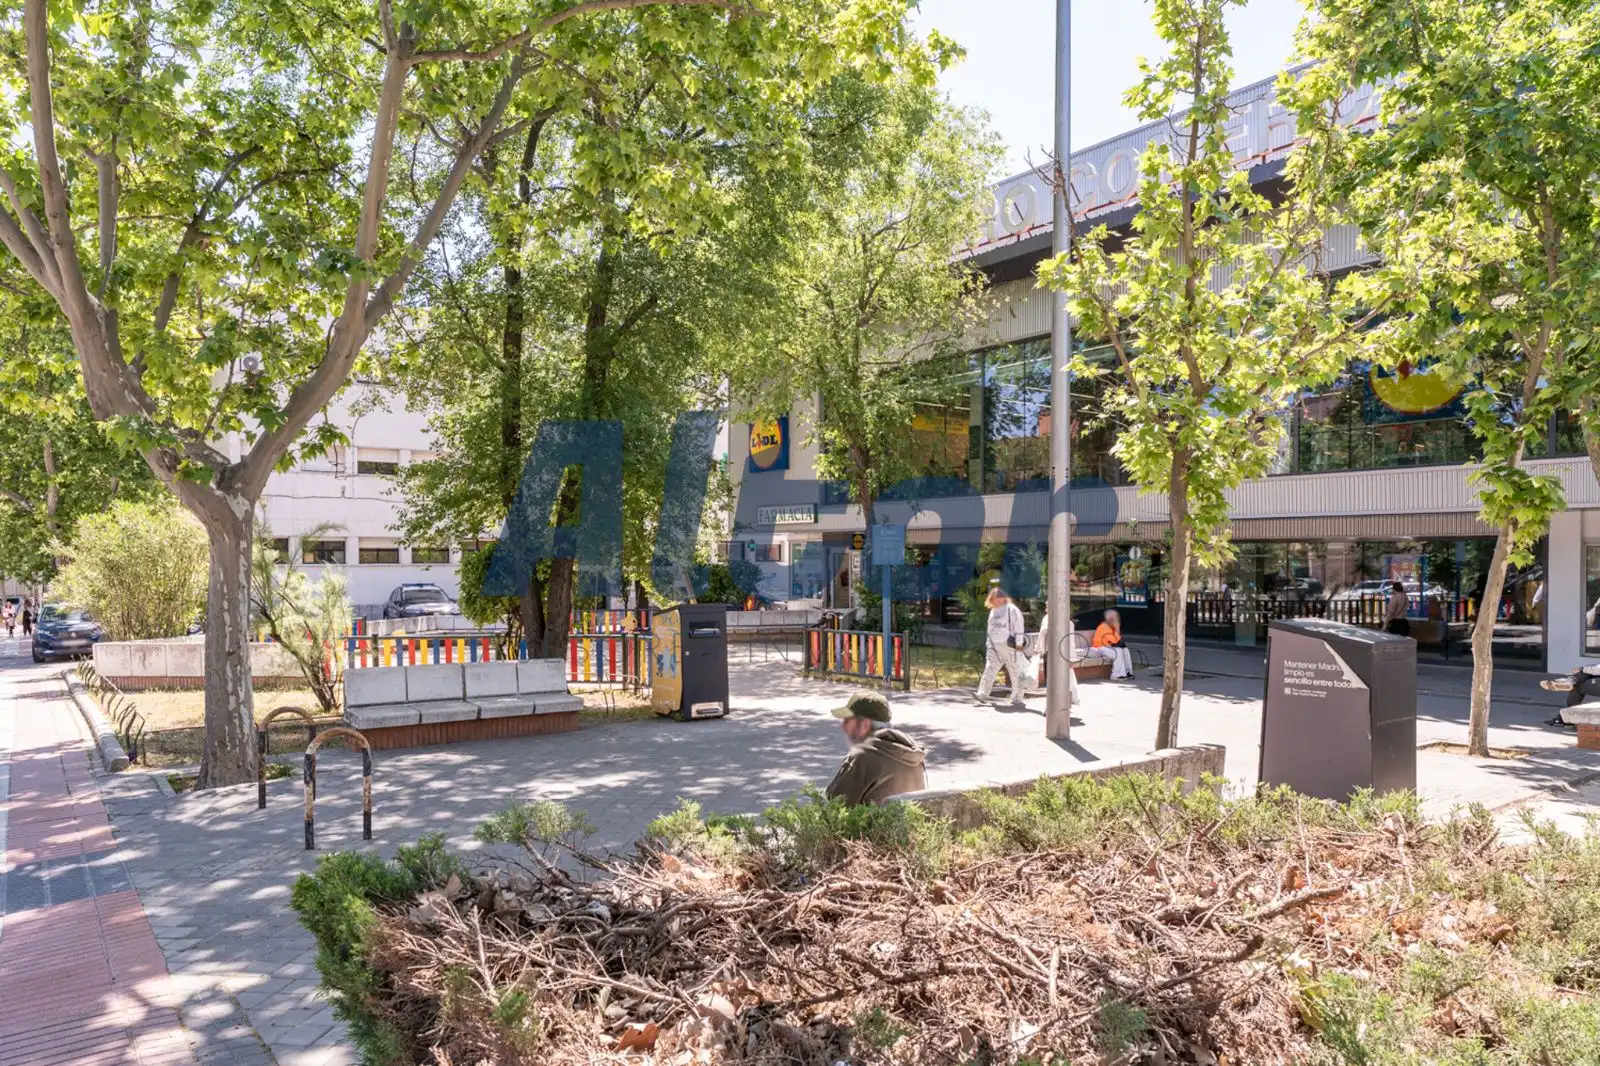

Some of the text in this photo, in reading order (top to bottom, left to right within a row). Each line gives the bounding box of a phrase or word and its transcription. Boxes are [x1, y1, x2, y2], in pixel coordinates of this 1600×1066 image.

[759, 508, 813, 522] FARMACIA
[1284, 660, 1317, 670] Mantener
[1284, 668, 1305, 676] limpio
[1284, 677, 1312, 685] sencillo
